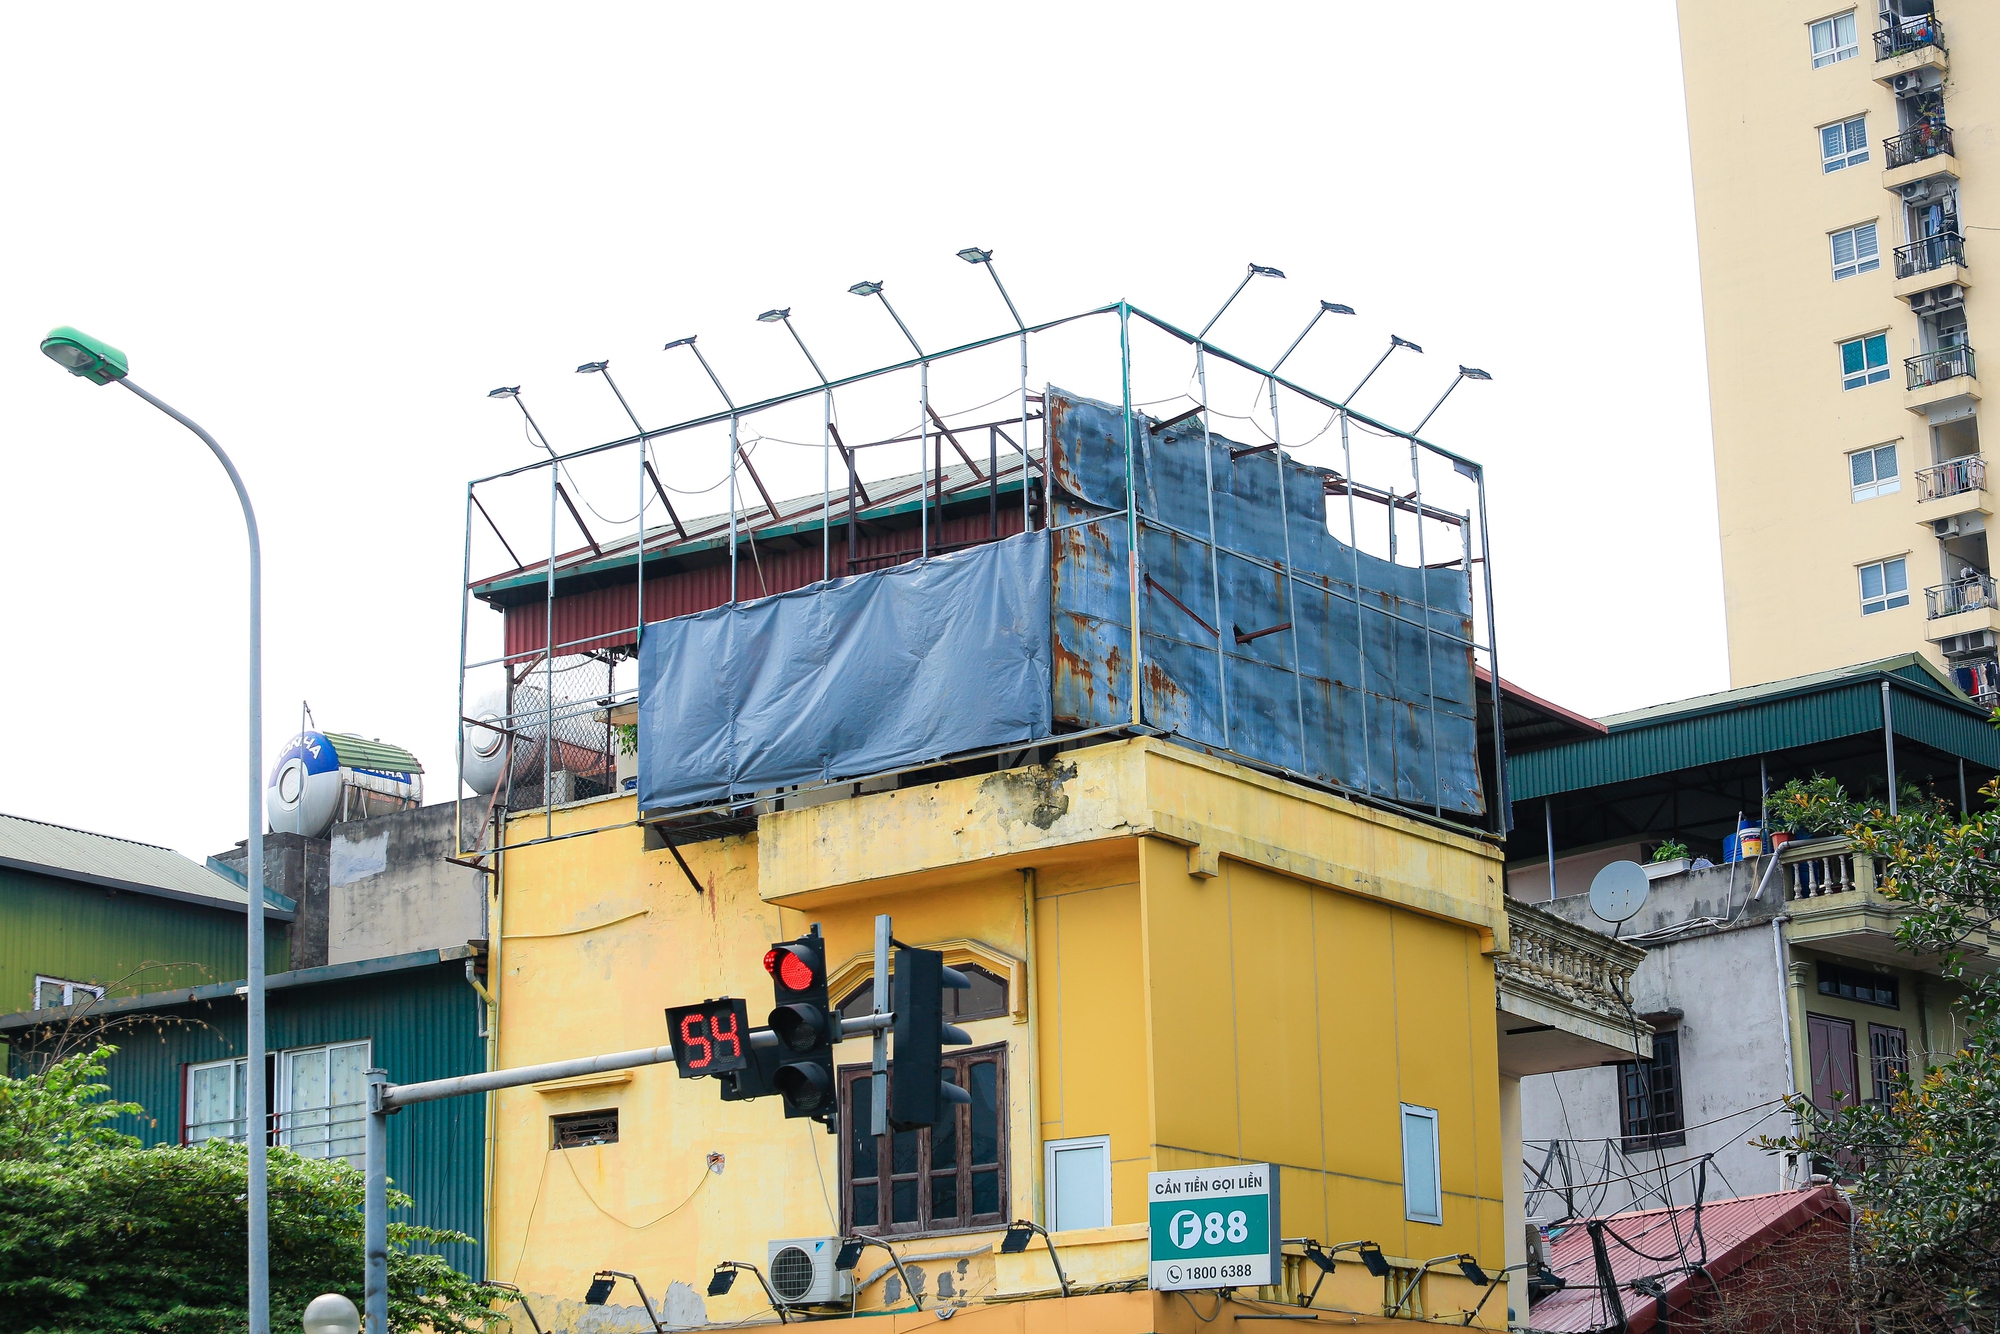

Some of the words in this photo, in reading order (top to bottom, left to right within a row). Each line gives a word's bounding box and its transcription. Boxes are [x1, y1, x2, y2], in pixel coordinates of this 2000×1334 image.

[681, 1013, 740, 1068] 54
[1155, 1178, 1181, 1194] CẦN
[1184, 1175, 1208, 1193] TIỀN
[1212, 1179, 1235, 1193] GỌI
[1238, 1171, 1262, 1189] LIỀN
[1169, 1210, 1248, 1249] F88
[1186, 1267, 1217, 1280] 1800
[1220, 1264, 1252, 1278] 6388
